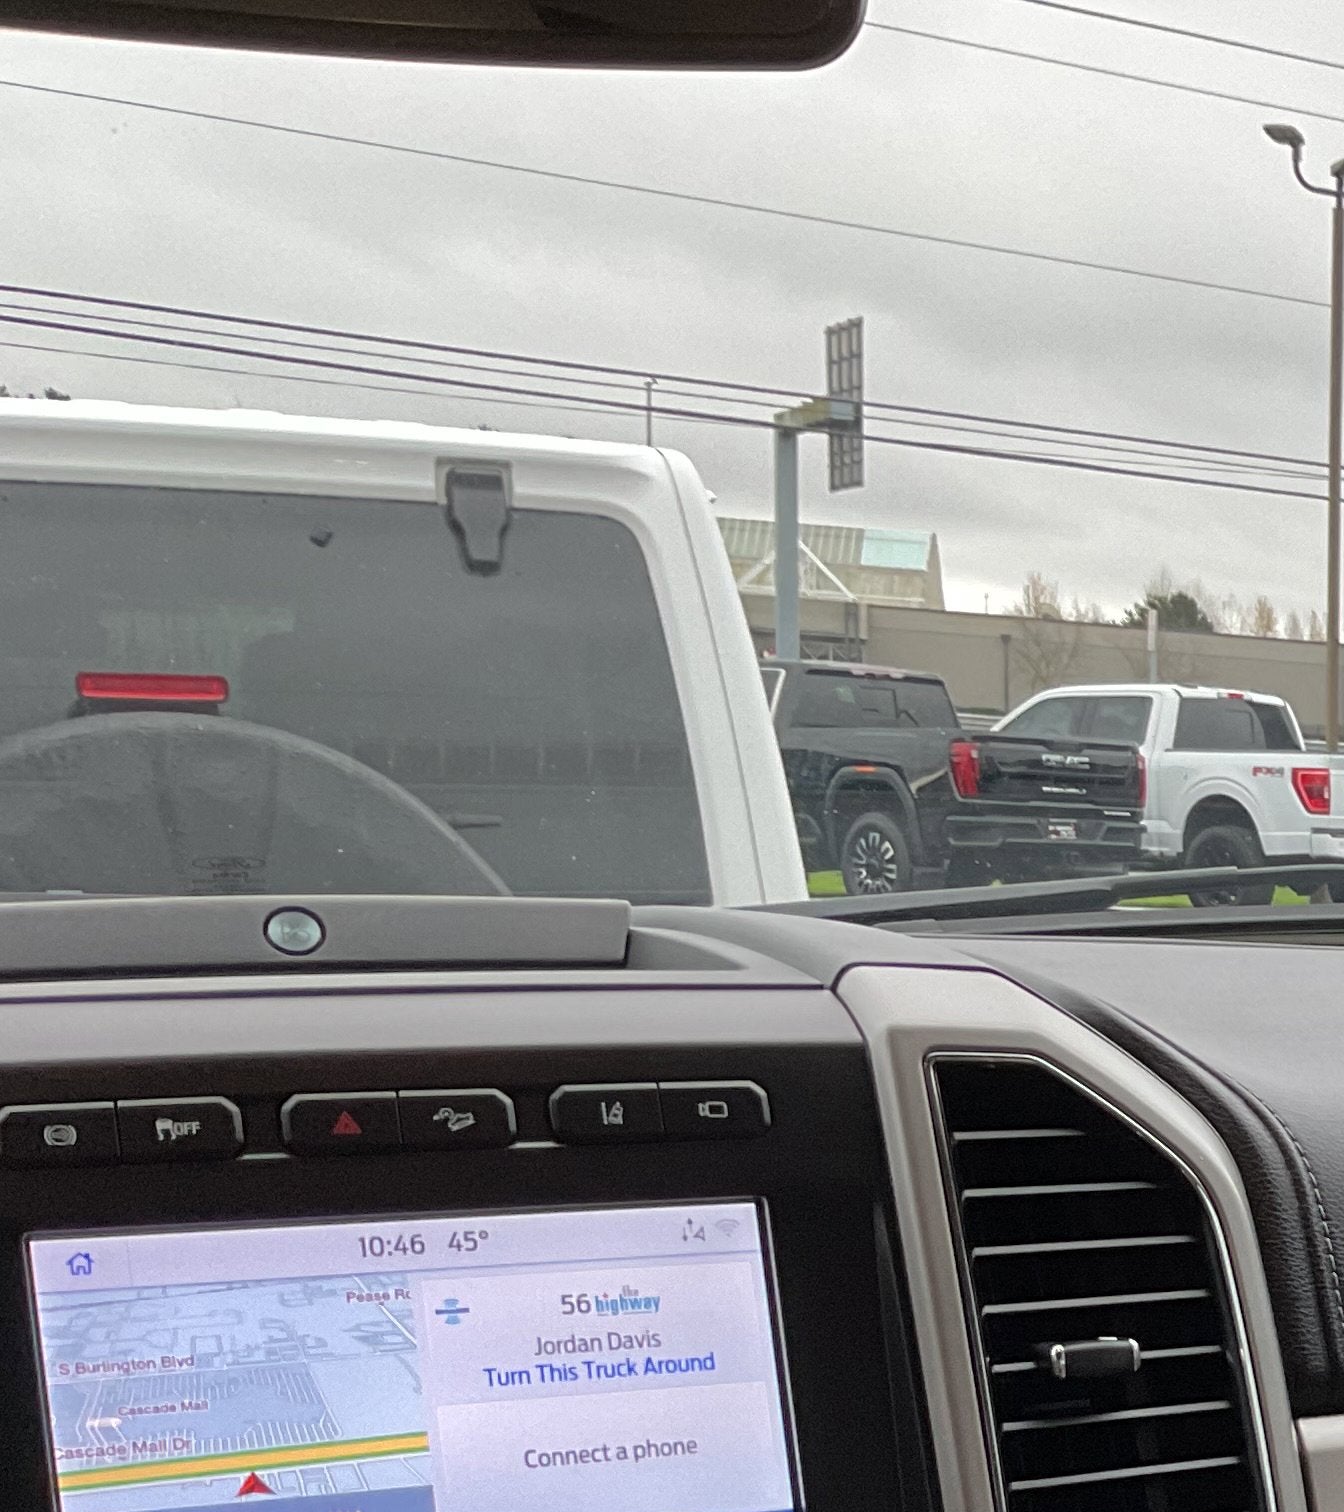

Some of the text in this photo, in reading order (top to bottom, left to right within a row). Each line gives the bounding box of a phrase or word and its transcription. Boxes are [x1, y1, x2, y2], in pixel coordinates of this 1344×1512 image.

[173, 1121, 200, 1136] OFF
[358, 1230, 489, 1258] 10:46 45°
[560, 1293, 661, 1316] 56 highway
[534, 1330, 662, 1356] Jordan Davis
[58, 1355, 195, 1375] S Burlington Blvd
[483, 1353, 716, 1388] Turn This Truck Around
[117, 1403, 177, 1416] Cascade
[132, 1439, 167, 1453] Mall
[172, 1437, 193, 1450] Dr
[524, 1438, 698, 1469] Connect a phone
